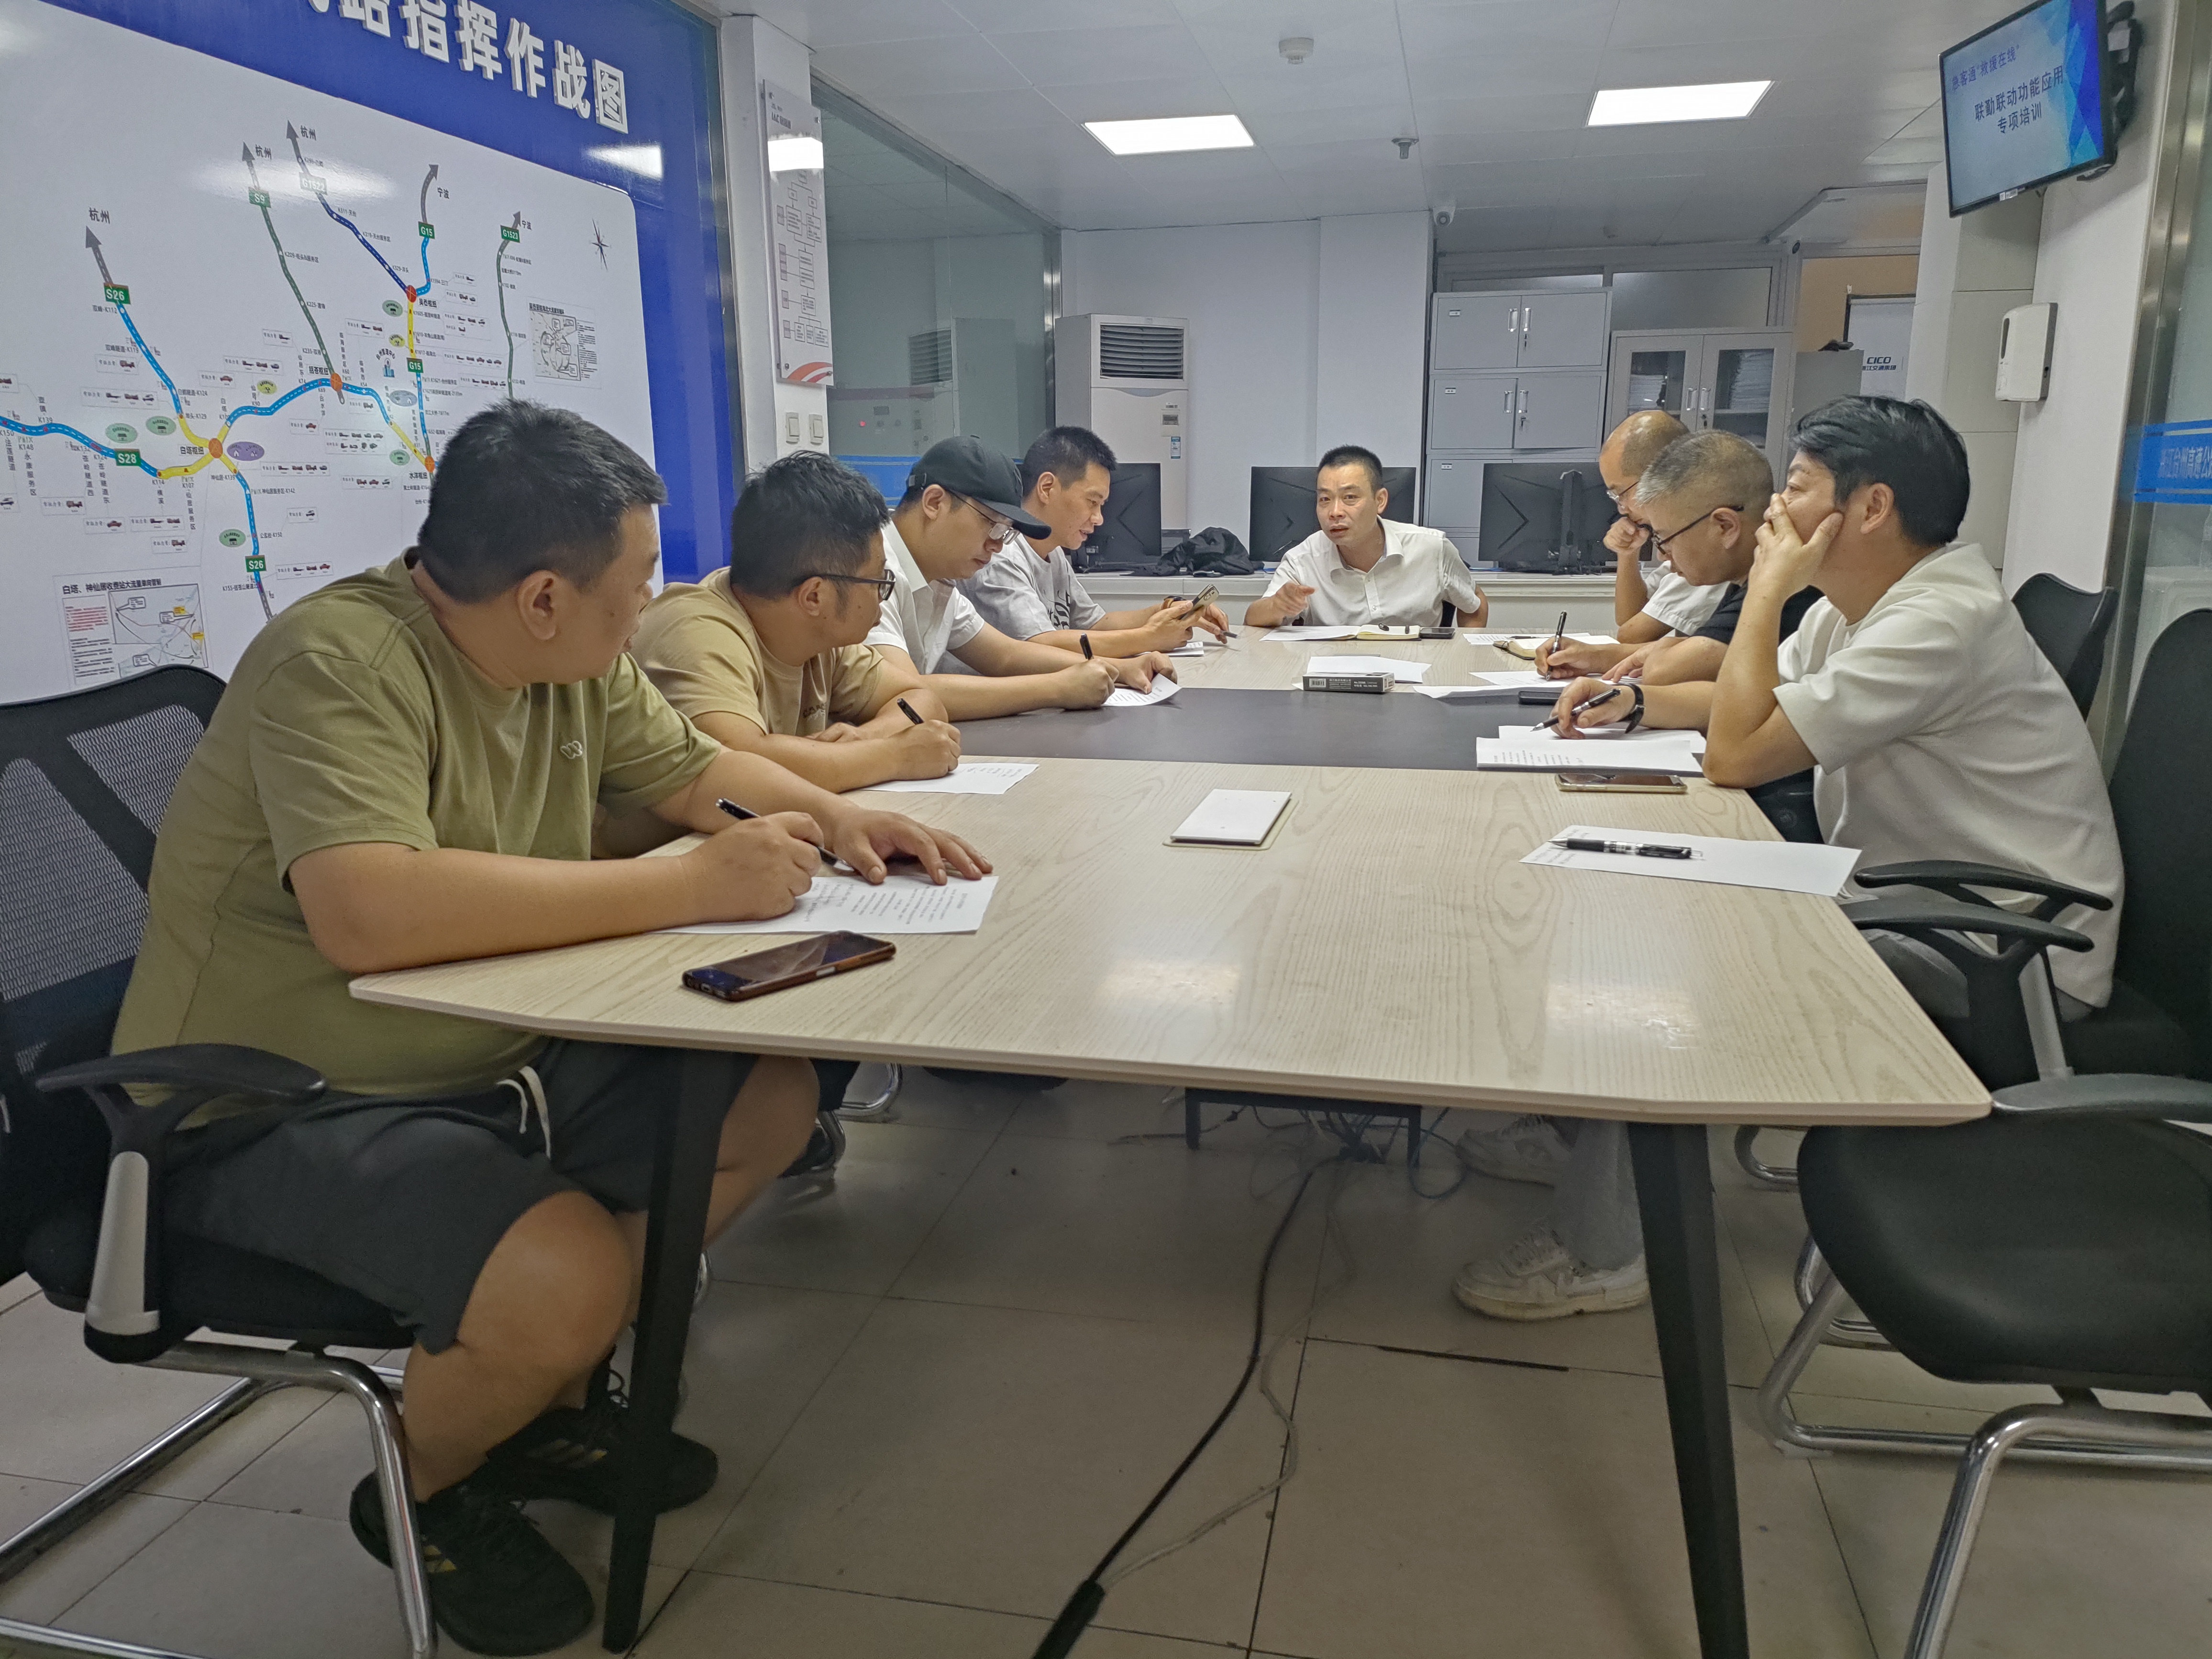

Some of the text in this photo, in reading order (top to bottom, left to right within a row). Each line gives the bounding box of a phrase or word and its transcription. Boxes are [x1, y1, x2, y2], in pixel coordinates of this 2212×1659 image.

[1975, 65, 2064, 122] 联勤联动功能应用
[1998, 101, 2042, 133] 专项培训
[300, 125, 316, 141] 杭州
[255, 144, 272, 160] 杭州
[302, 178, 325, 192] G1522
[254, 193, 266, 205] S9
[437, 187, 450, 199] 宁波
[88, 207, 111, 224] 杭州
[522, 220, 532, 231] 宁波
[420, 226, 433, 238] G15
[503, 229, 519, 240] G1523
[106, 289, 125, 300] S26
[309, 365, 329, 376] 括苍枢纽
[180, 446, 205, 455] 白塔枢纽
[118, 453, 137, 464] S28
[24, 453, 37, 496] 永康服务区
[248, 560, 264, 569] S26
[63, 578, 162, 595] 白塔、神仙居收费站大流量单向管制
